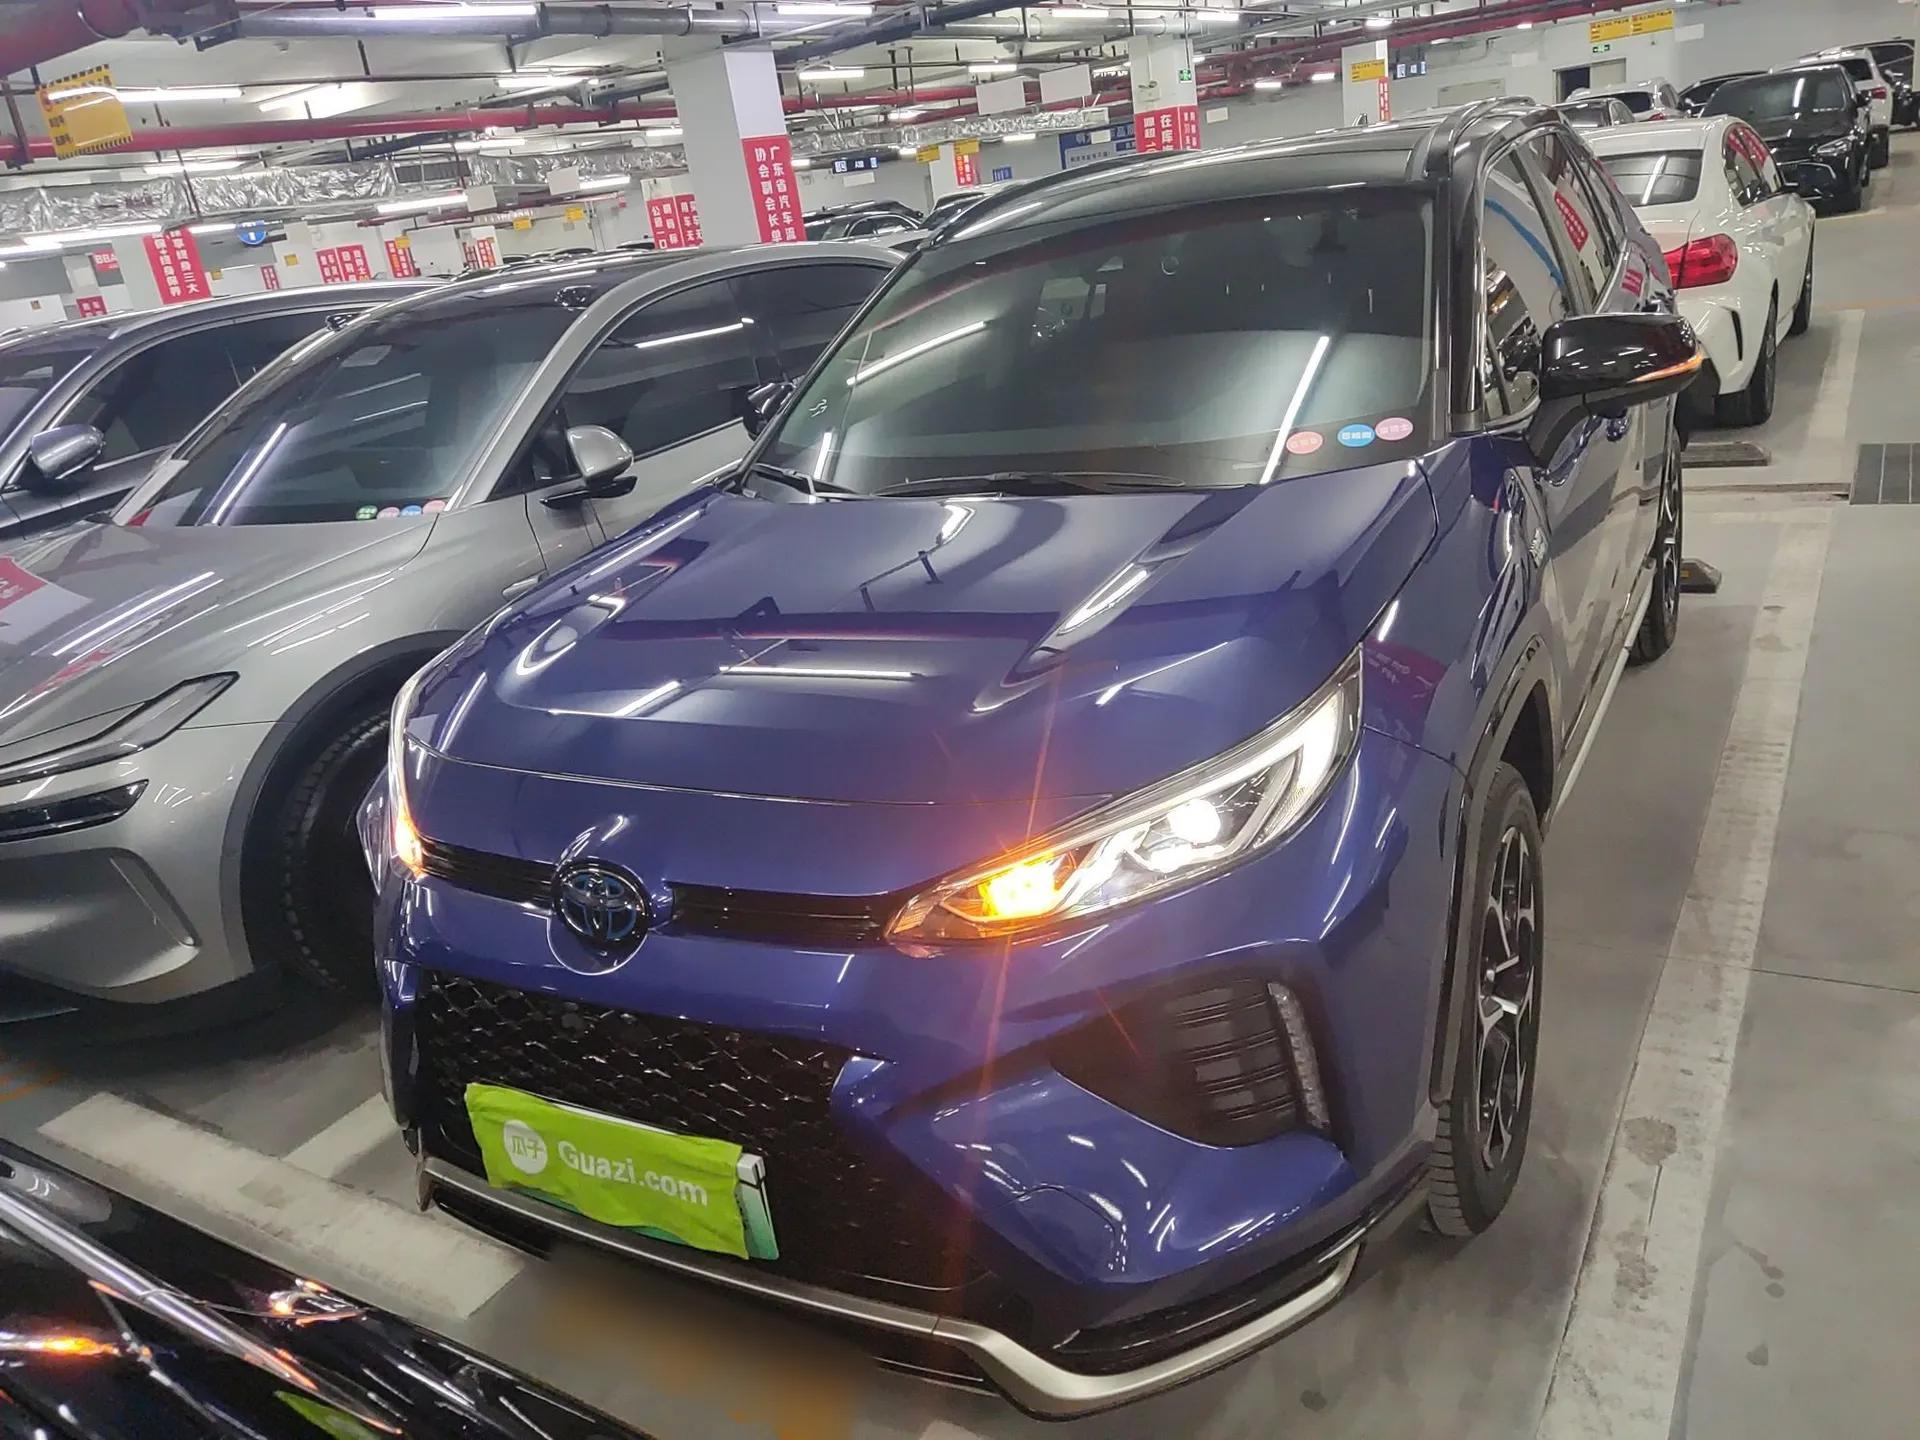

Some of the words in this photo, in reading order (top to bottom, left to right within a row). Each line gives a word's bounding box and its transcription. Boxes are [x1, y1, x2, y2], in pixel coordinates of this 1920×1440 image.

[754, 147, 782, 242] 协会副会长单
[769, 145, 797, 240] 广东省汽车流
[511, 1134, 545, 1161] 瓜子
[557, 1140, 708, 1208] Guazi.com
